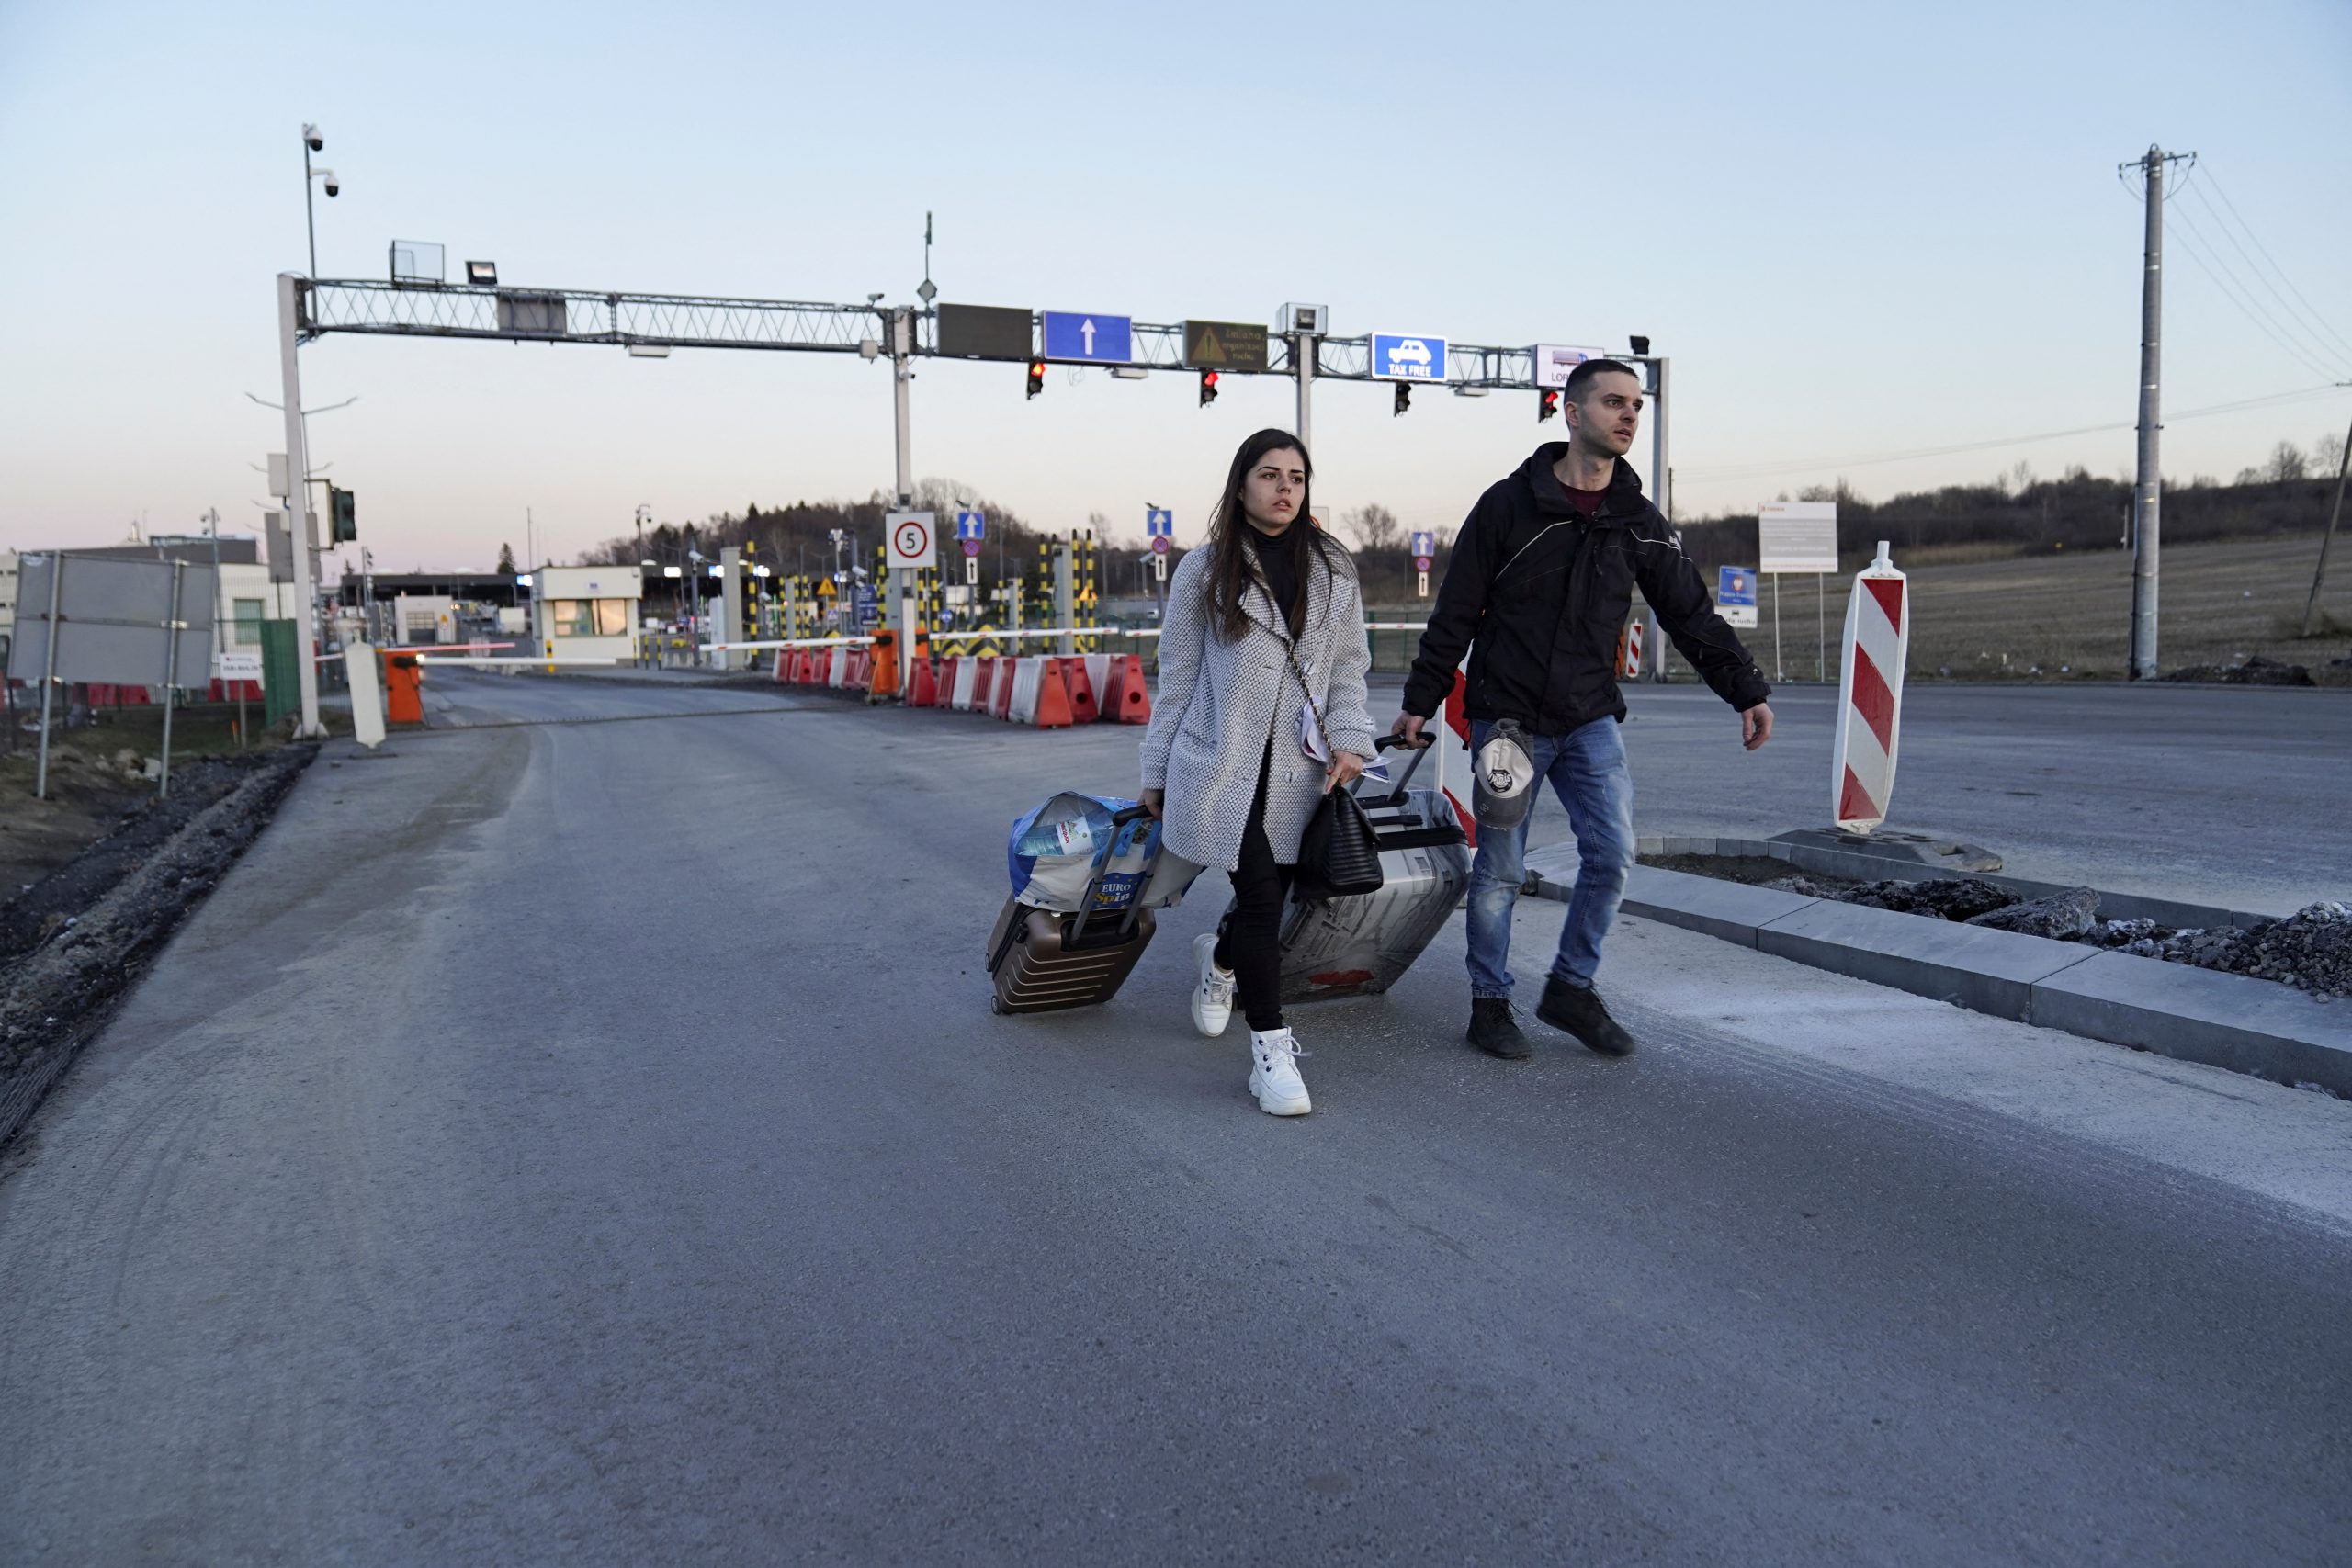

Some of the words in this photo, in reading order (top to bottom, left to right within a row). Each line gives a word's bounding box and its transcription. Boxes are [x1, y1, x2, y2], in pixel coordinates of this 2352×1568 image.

[1388, 363, 1407, 376] TAX
[1408, 364, 1432, 378] FREE
[1551, 371, 1570, 382] LOR
[905, 532, 916, 550] 5
[1102, 883, 1132, 893] EURO
[1094, 892, 1131, 905] Spin
